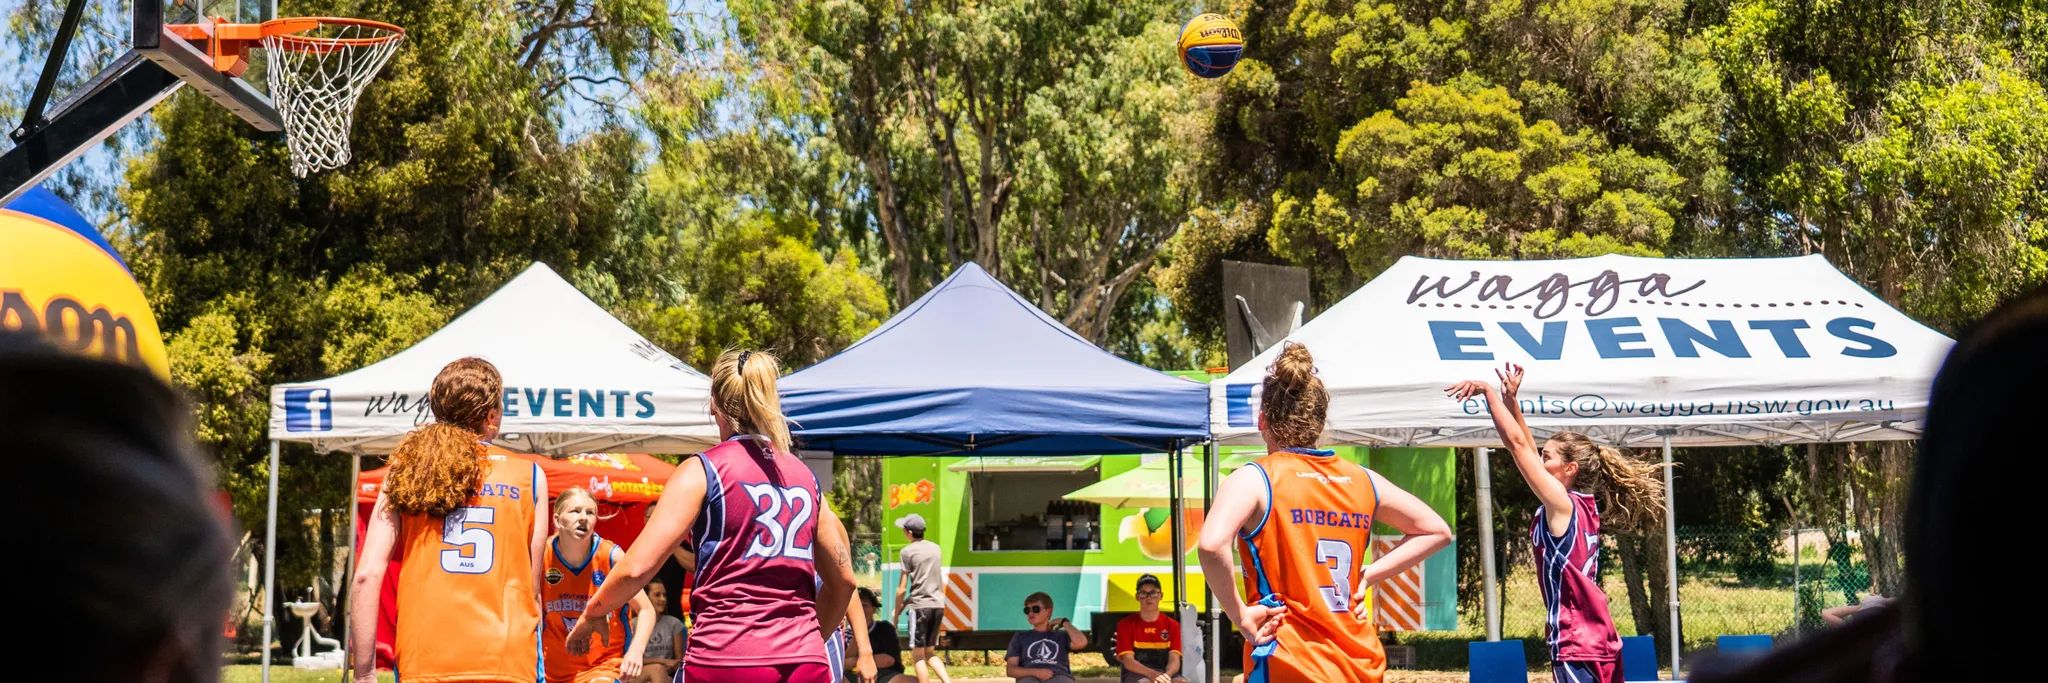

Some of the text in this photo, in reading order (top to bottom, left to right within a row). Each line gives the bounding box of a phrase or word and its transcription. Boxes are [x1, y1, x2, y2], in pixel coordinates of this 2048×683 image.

[1200, 27, 1240, 40] Wilson
[1406, 269, 1706, 319] wagga
[1428, 316, 1897, 361] EVENTS
[502, 387, 656, 419] EVENTS
[1463, 393, 1894, 418] ents@wagga.nsw.gov.au
[889, 478, 936, 510] BOOST
[739, 482, 814, 562] 32
[1290, 508, 1370, 530] BOBCATS
[440, 506, 495, 575] 5
[1316, 538, 1352, 613] 3
